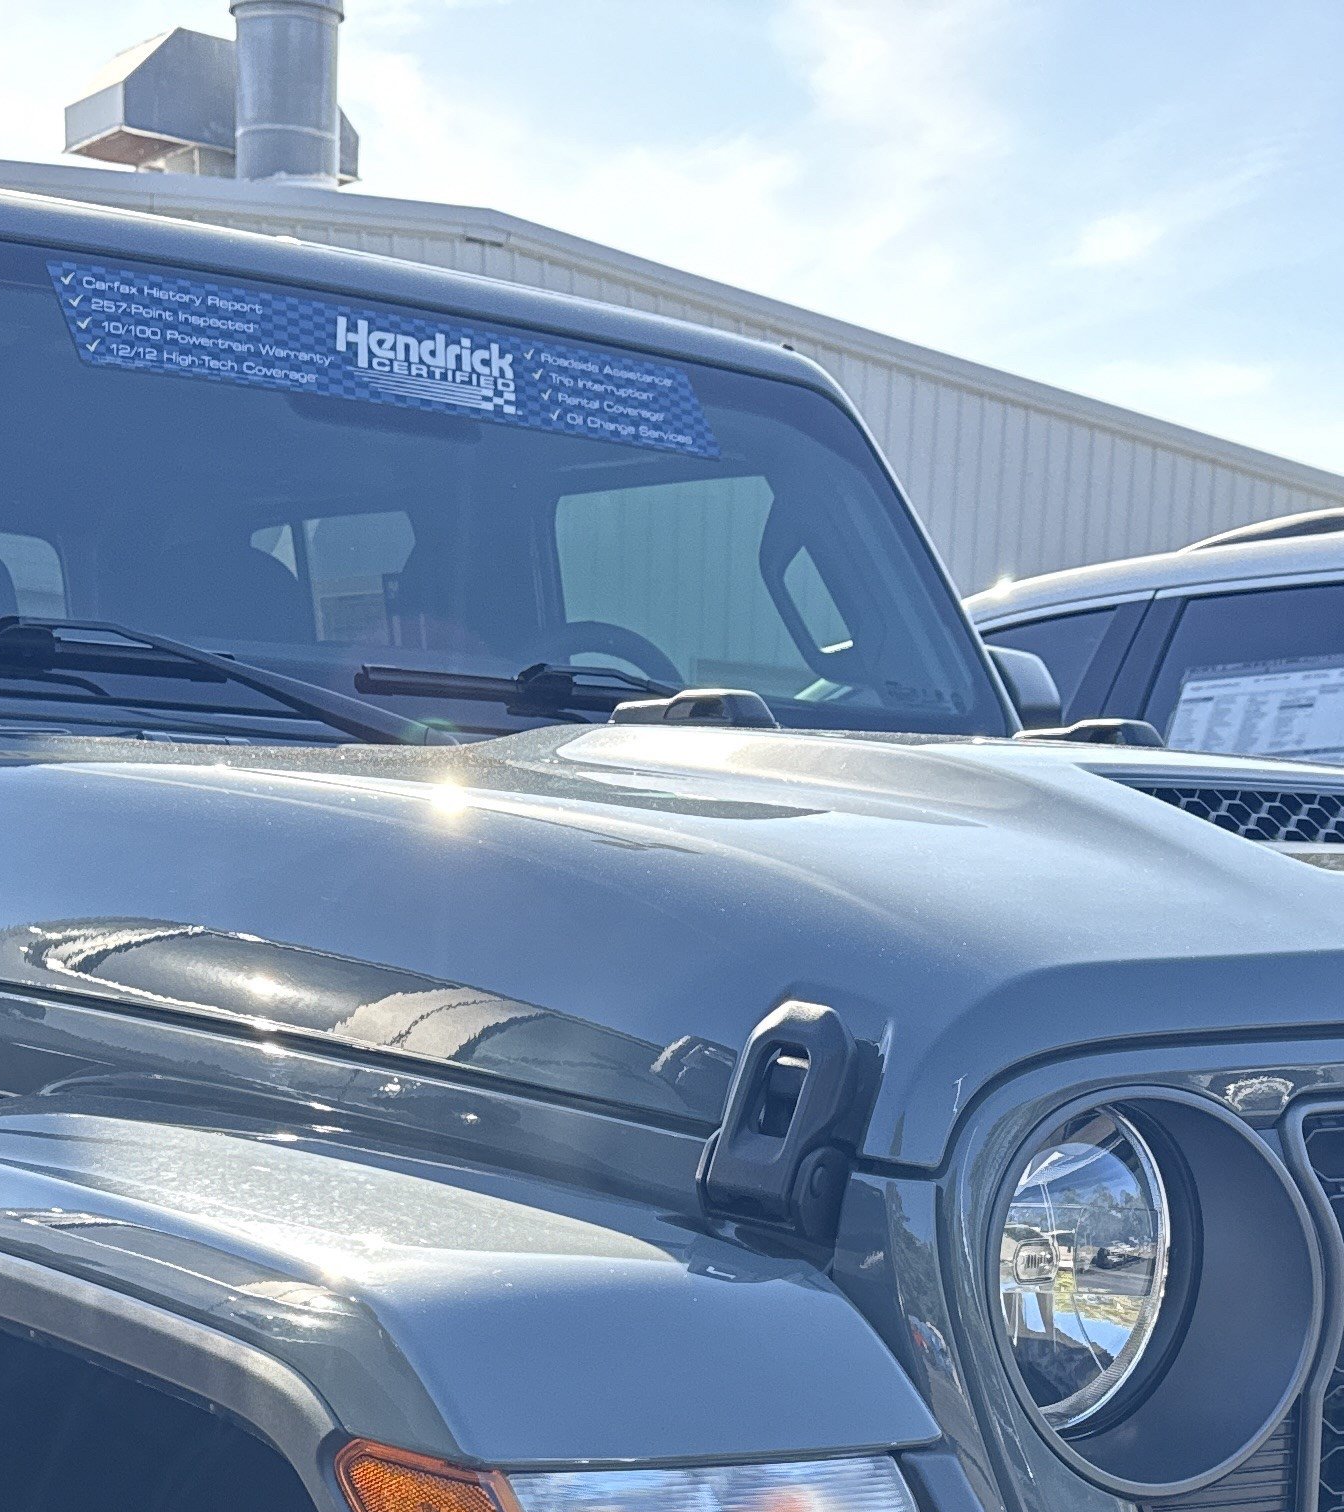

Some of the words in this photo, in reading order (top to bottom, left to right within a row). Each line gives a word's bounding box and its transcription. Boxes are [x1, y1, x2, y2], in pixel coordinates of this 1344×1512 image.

[82, 277, 137, 296] Carfax
[144, 285, 202, 307] History
[208, 296, 263, 315] Report
[102, 322, 161, 341] 10/100
[167, 329, 254, 353] Powertrain
[336, 315, 514, 380] Hendrick
[110, 343, 157, 361] 12/12
[163, 351, 237, 372] High-Tech
[372, 357, 515, 392] CERTIFIED
[541, 353, 600, 374] Roadside
[603, 364, 673, 388] Assistance
[587, 416, 636, 436] Change
[639, 425, 693, 446] Services
